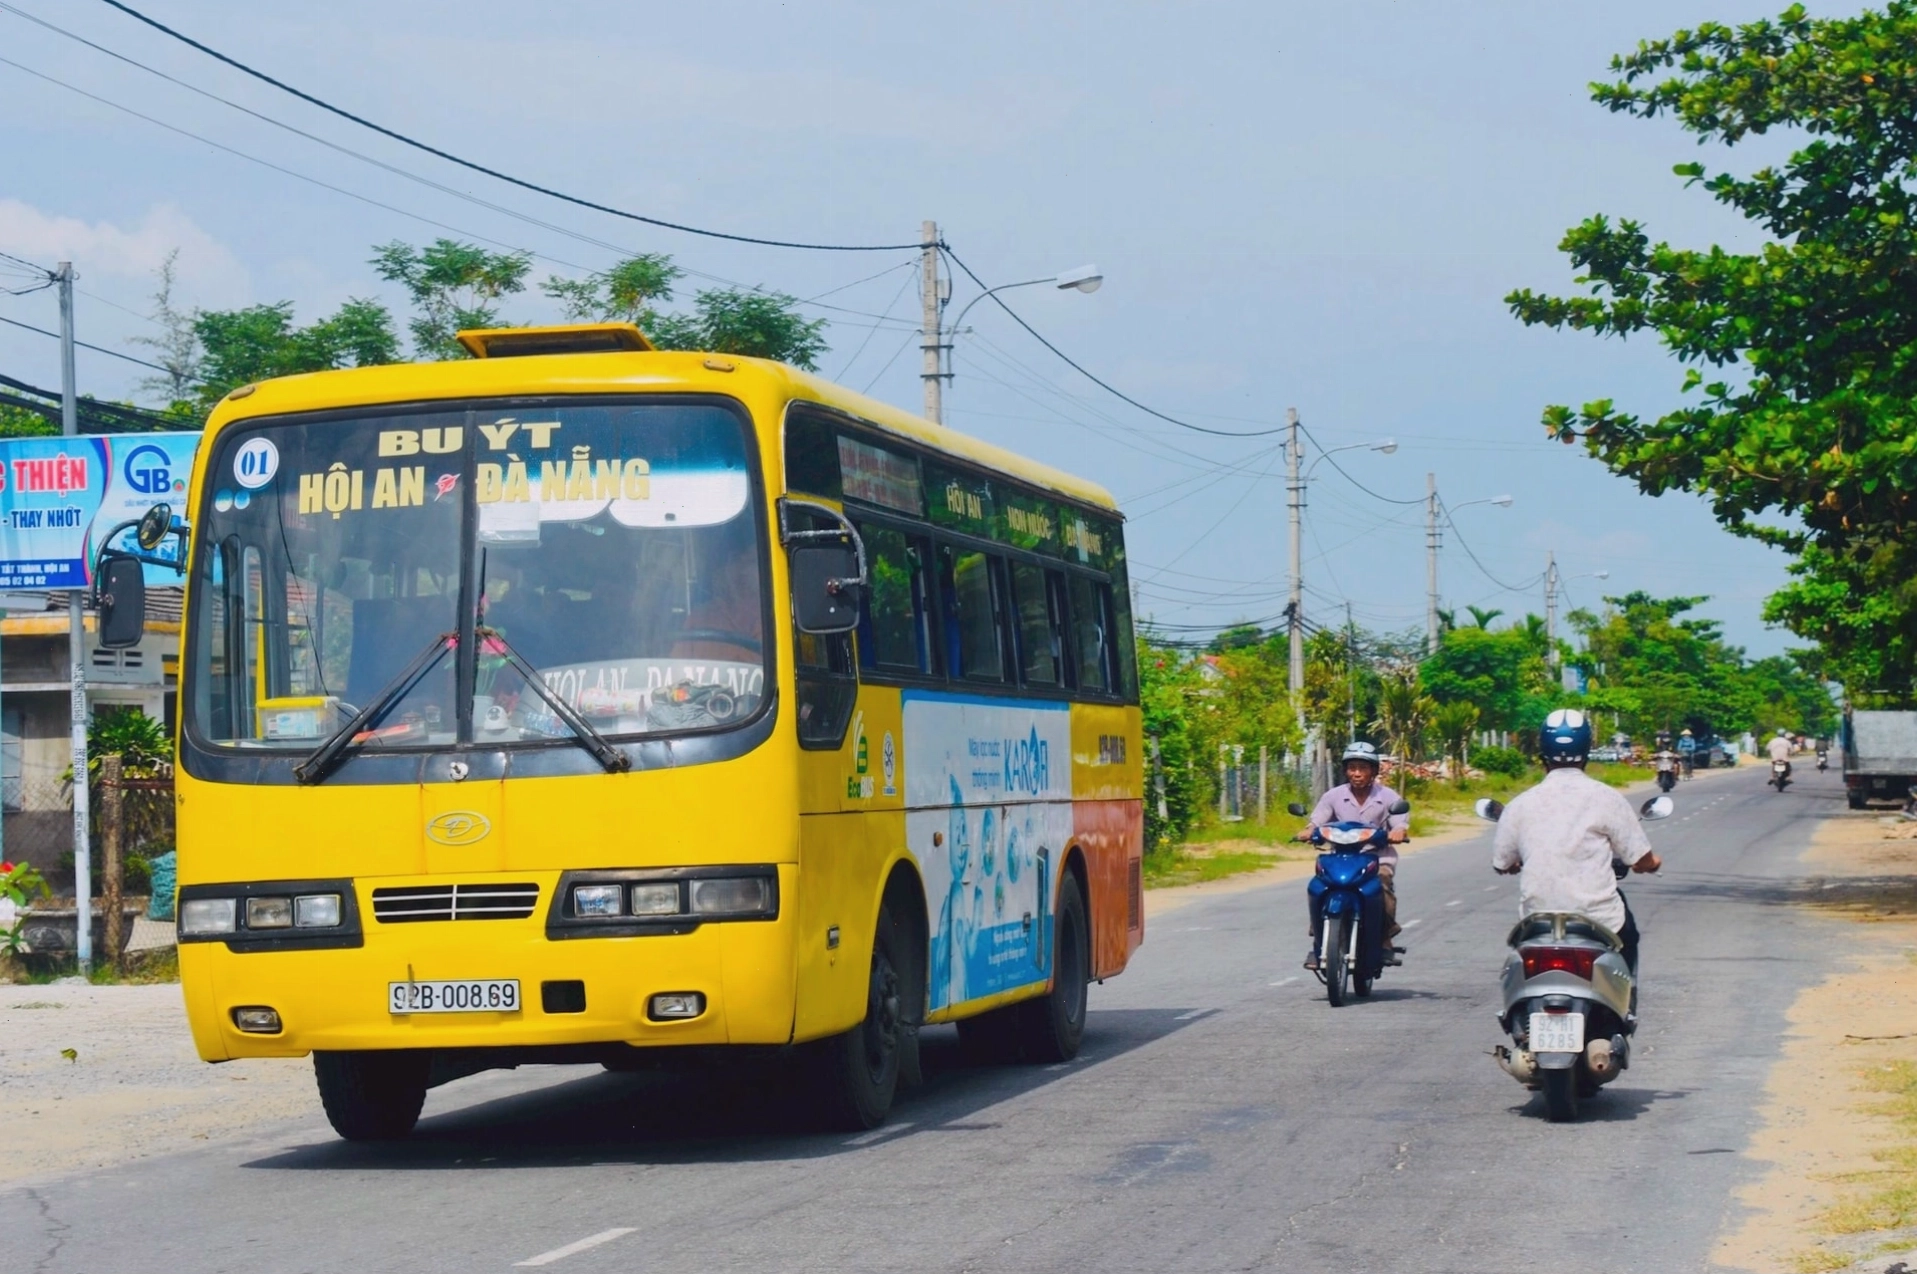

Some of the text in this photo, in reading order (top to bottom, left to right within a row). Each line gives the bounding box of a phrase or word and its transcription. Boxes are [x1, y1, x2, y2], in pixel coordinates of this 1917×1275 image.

[378, 418, 561, 457] BU ÝT
[13, 453, 87, 496] THIỆN
[124, 444, 171, 493] GB
[241, 450, 268, 476] 01
[299, 445, 650, 519] HỘI AN ĐÀ NẴNG
[11, 510, 43, 528] THAY
[967, 493, 982, 520] AN
[393, 983, 516, 1009] 92B-008.69
[1538, 1033, 1575, 1049] 6285
